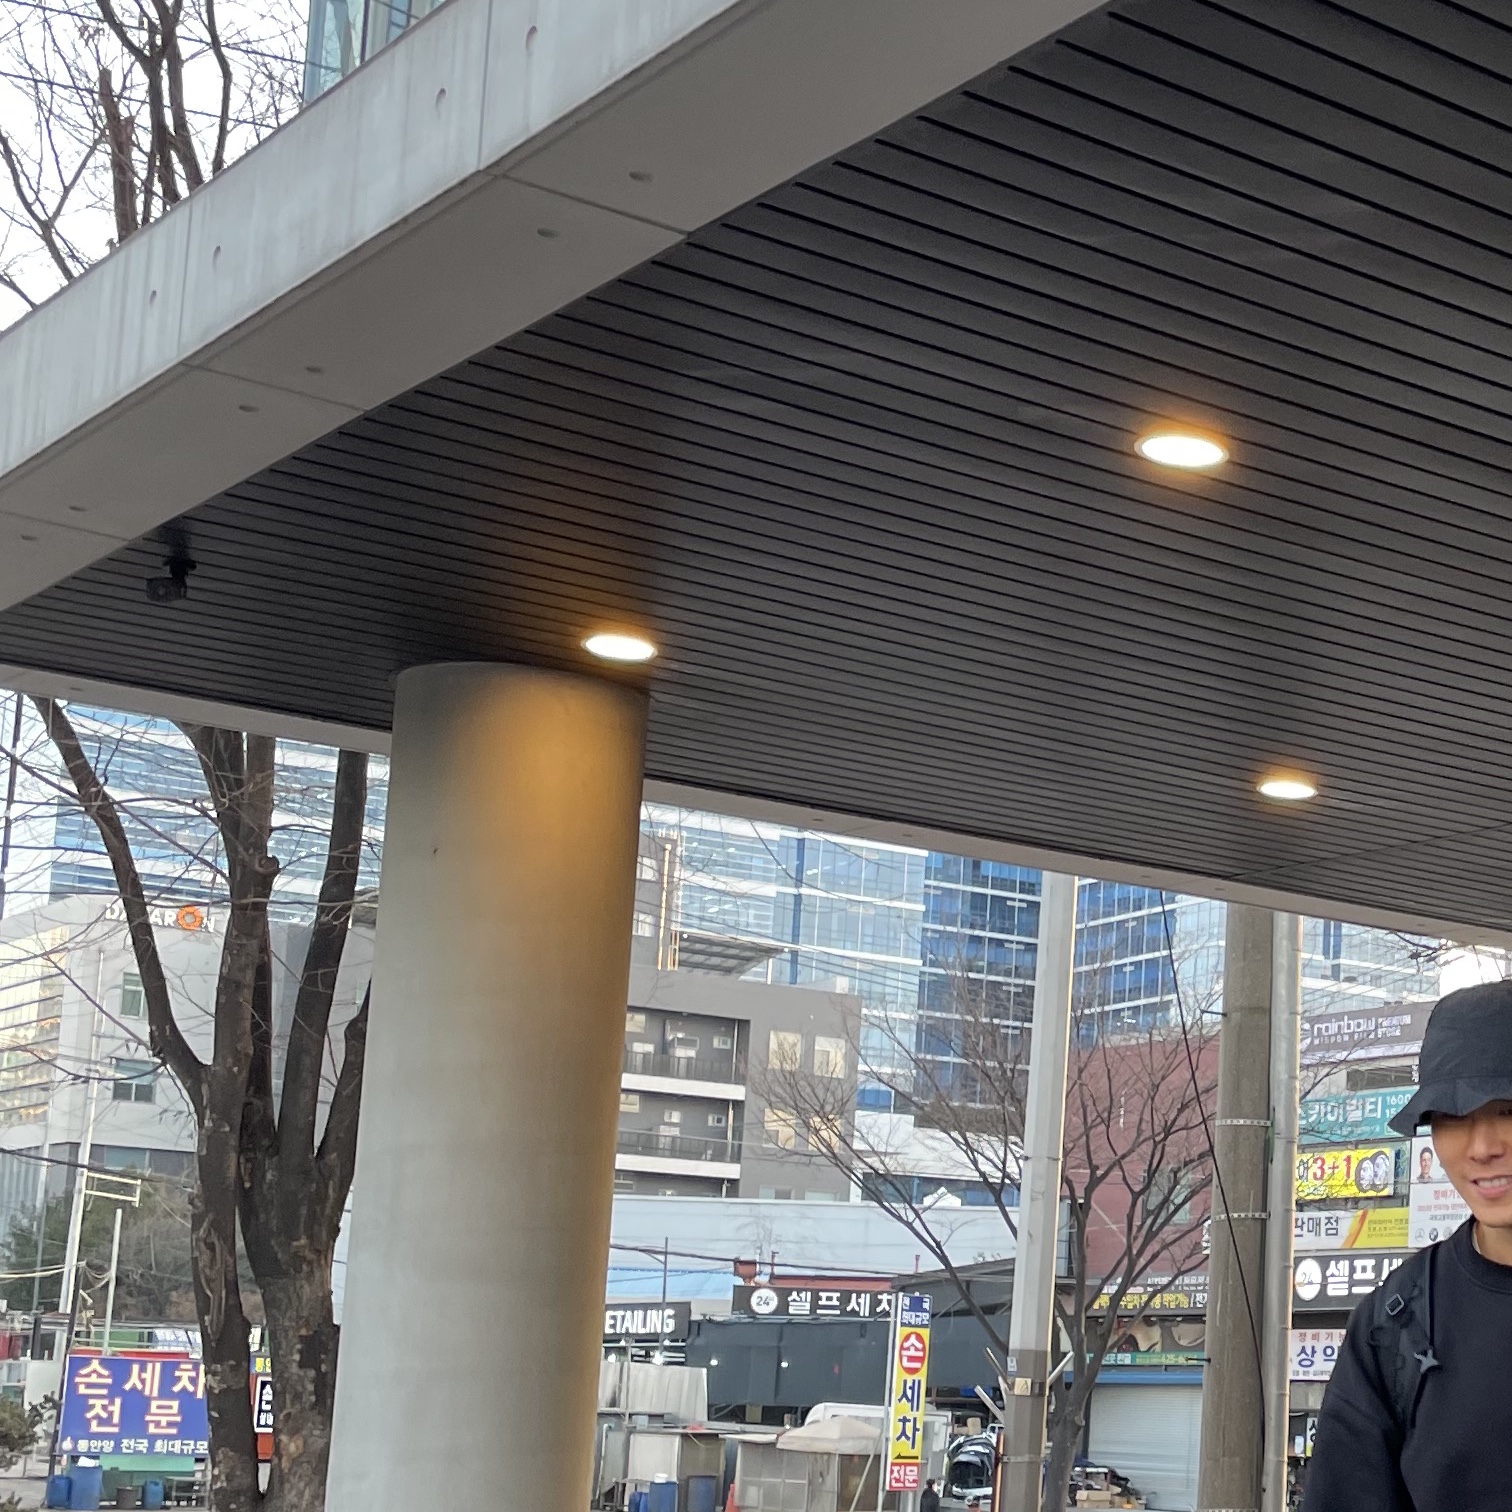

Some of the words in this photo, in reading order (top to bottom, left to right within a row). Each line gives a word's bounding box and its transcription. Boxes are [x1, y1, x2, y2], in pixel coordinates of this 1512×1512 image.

[1314, 1015, 1376, 1036] rainbow
[1313, 1154, 1351, 1182] 3+1
[85, 1397, 181, 1433] 전문
[120, 1437, 150, 1454] 전국
[890, 1465, 919, 1488] 전문
